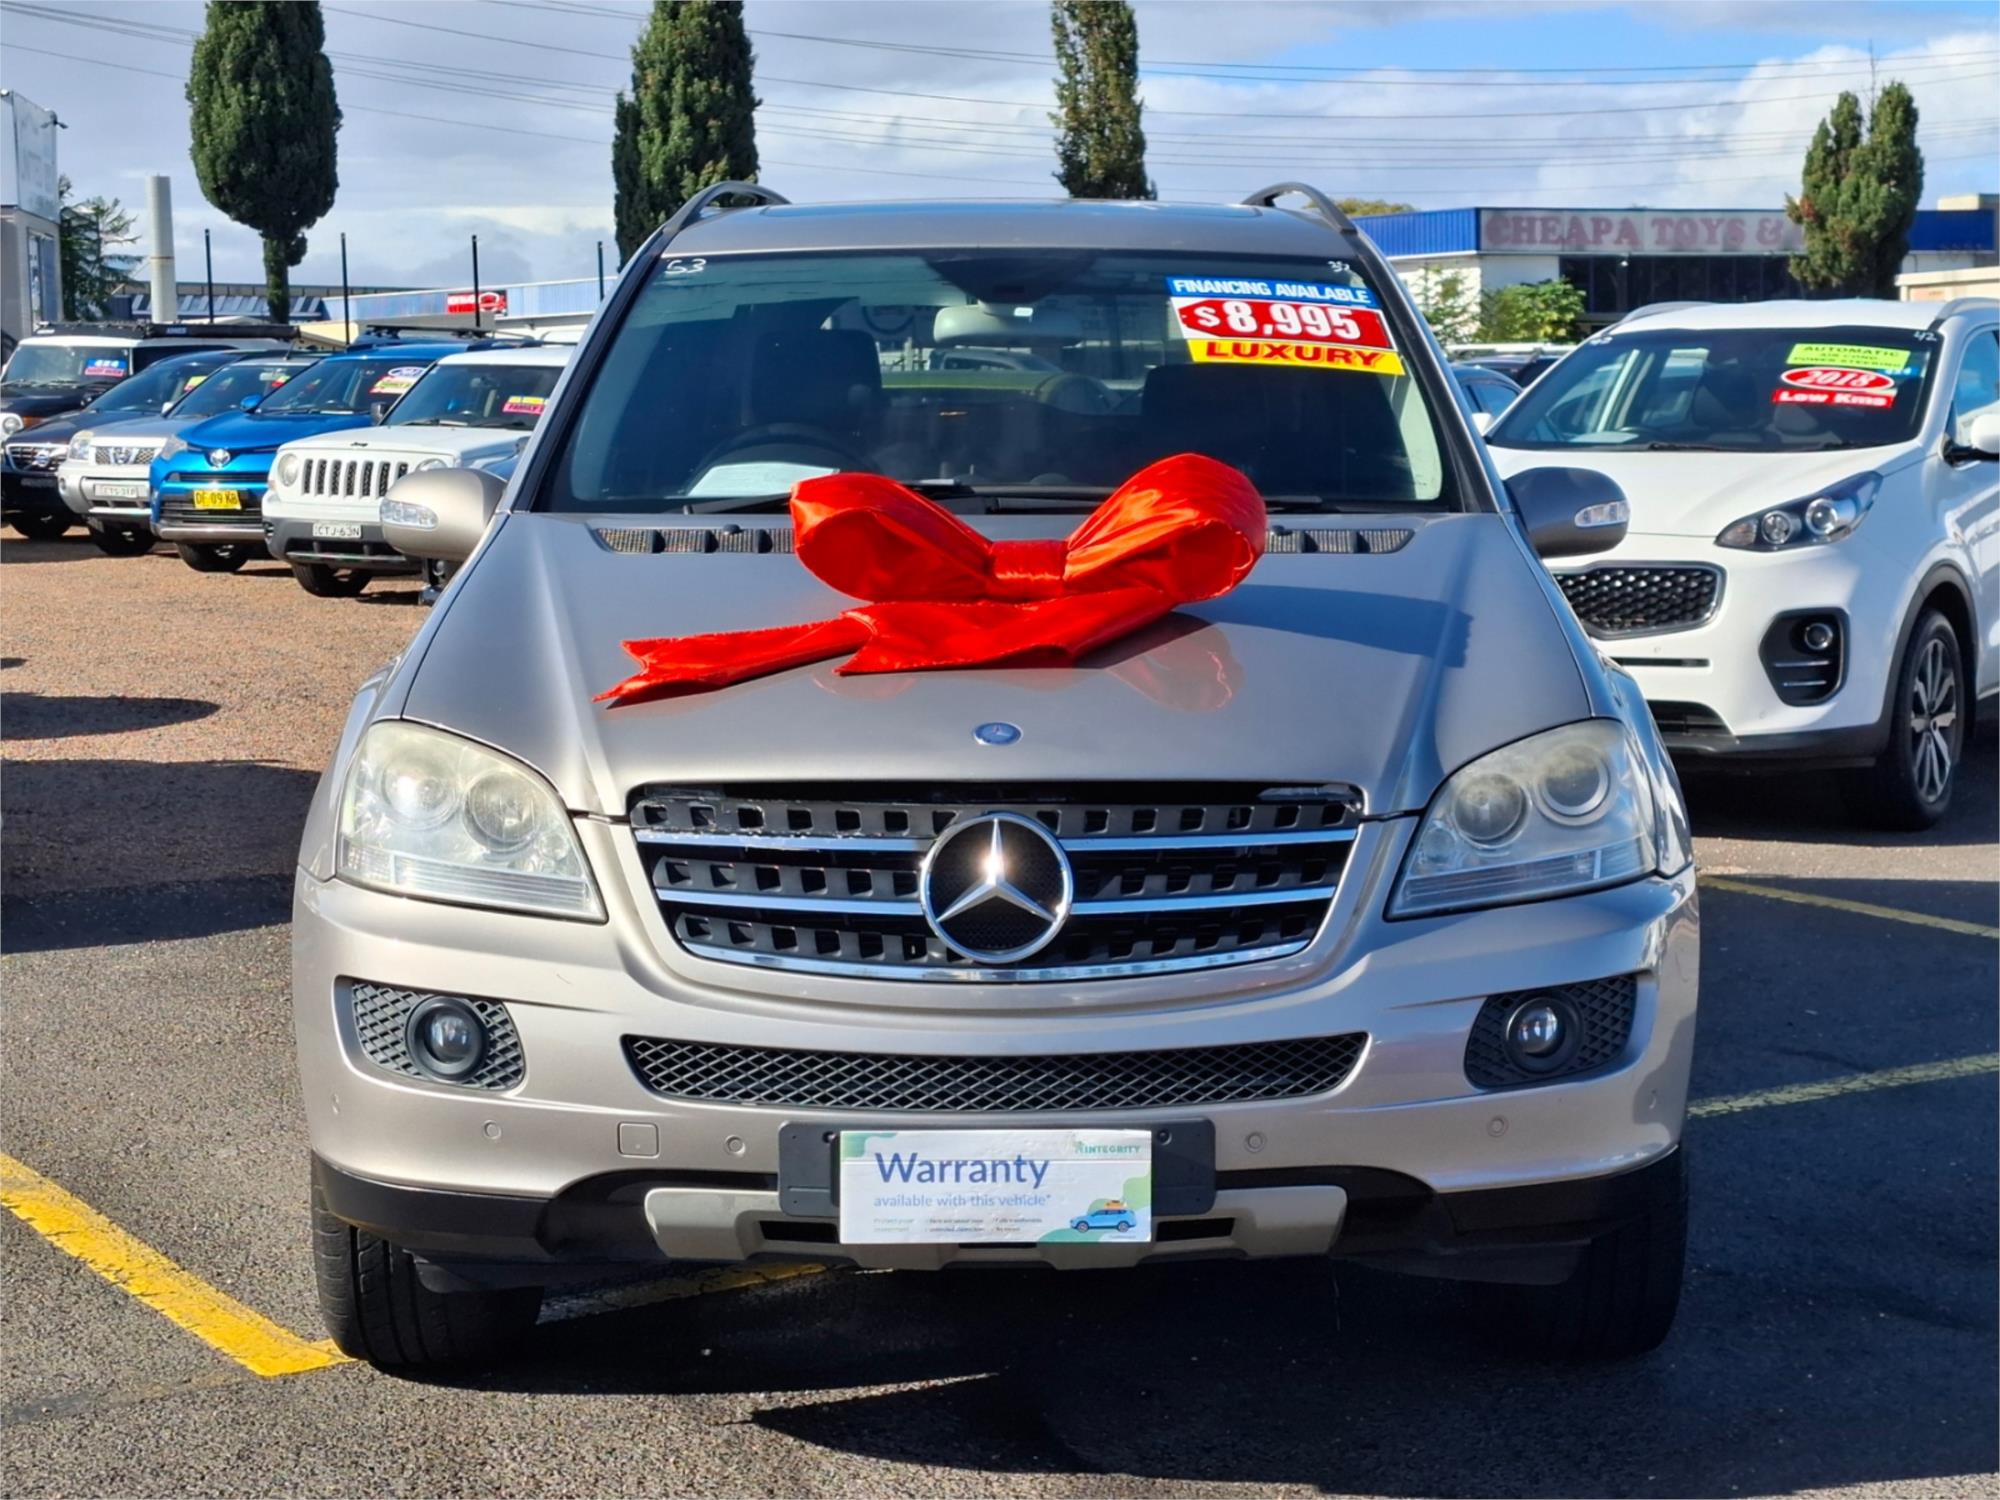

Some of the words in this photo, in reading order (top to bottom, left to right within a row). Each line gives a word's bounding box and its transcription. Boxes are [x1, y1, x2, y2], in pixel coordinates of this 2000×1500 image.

[1485, 215, 1643, 246] CHEAPA
[1652, 217, 1746, 246] TOYS
[1756, 217, 1784, 246] &
[1173, 279, 1273, 297] FINANCING
[1275, 283, 1372, 304] AVAILABLE
[1206, 341, 1384, 368] LUXURY
[1803, 345, 1900, 359] AUTOMATIC
[1797, 369, 1876, 388] 2018
[1779, 391, 1829, 402] Low
[1833, 393, 1888, 407] Kms
[874, 1152, 1050, 1189] Warranty
[873, 1193, 932, 1208] available
[936, 1193, 966, 1207] with
[969, 1193, 995, 1207] this
